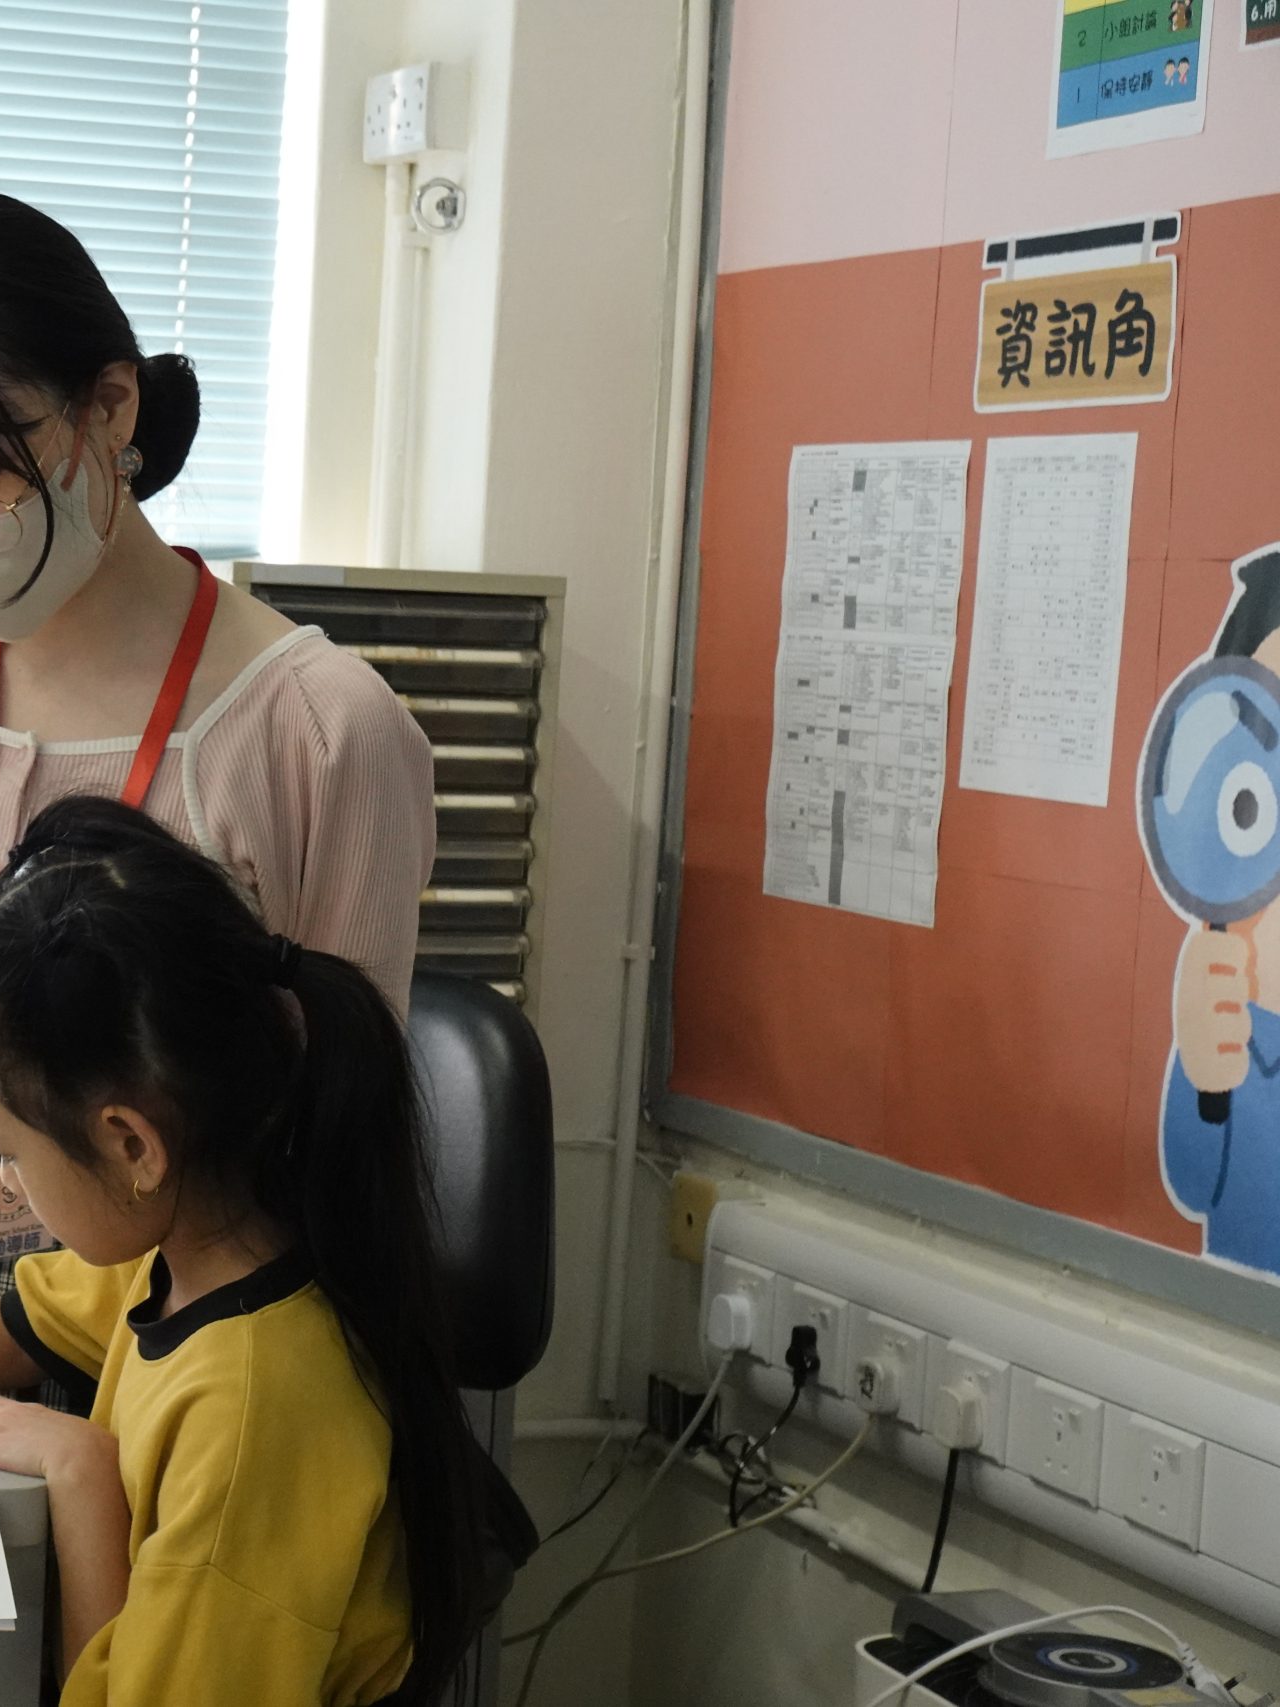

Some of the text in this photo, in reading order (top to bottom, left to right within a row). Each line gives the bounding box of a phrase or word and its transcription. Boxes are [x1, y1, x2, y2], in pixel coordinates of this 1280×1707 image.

[1077, 10, 1157, 47] 2 小組討論
[1100, 70, 1154, 99] 保持安靜
[995, 288, 1156, 388] 資訊角
